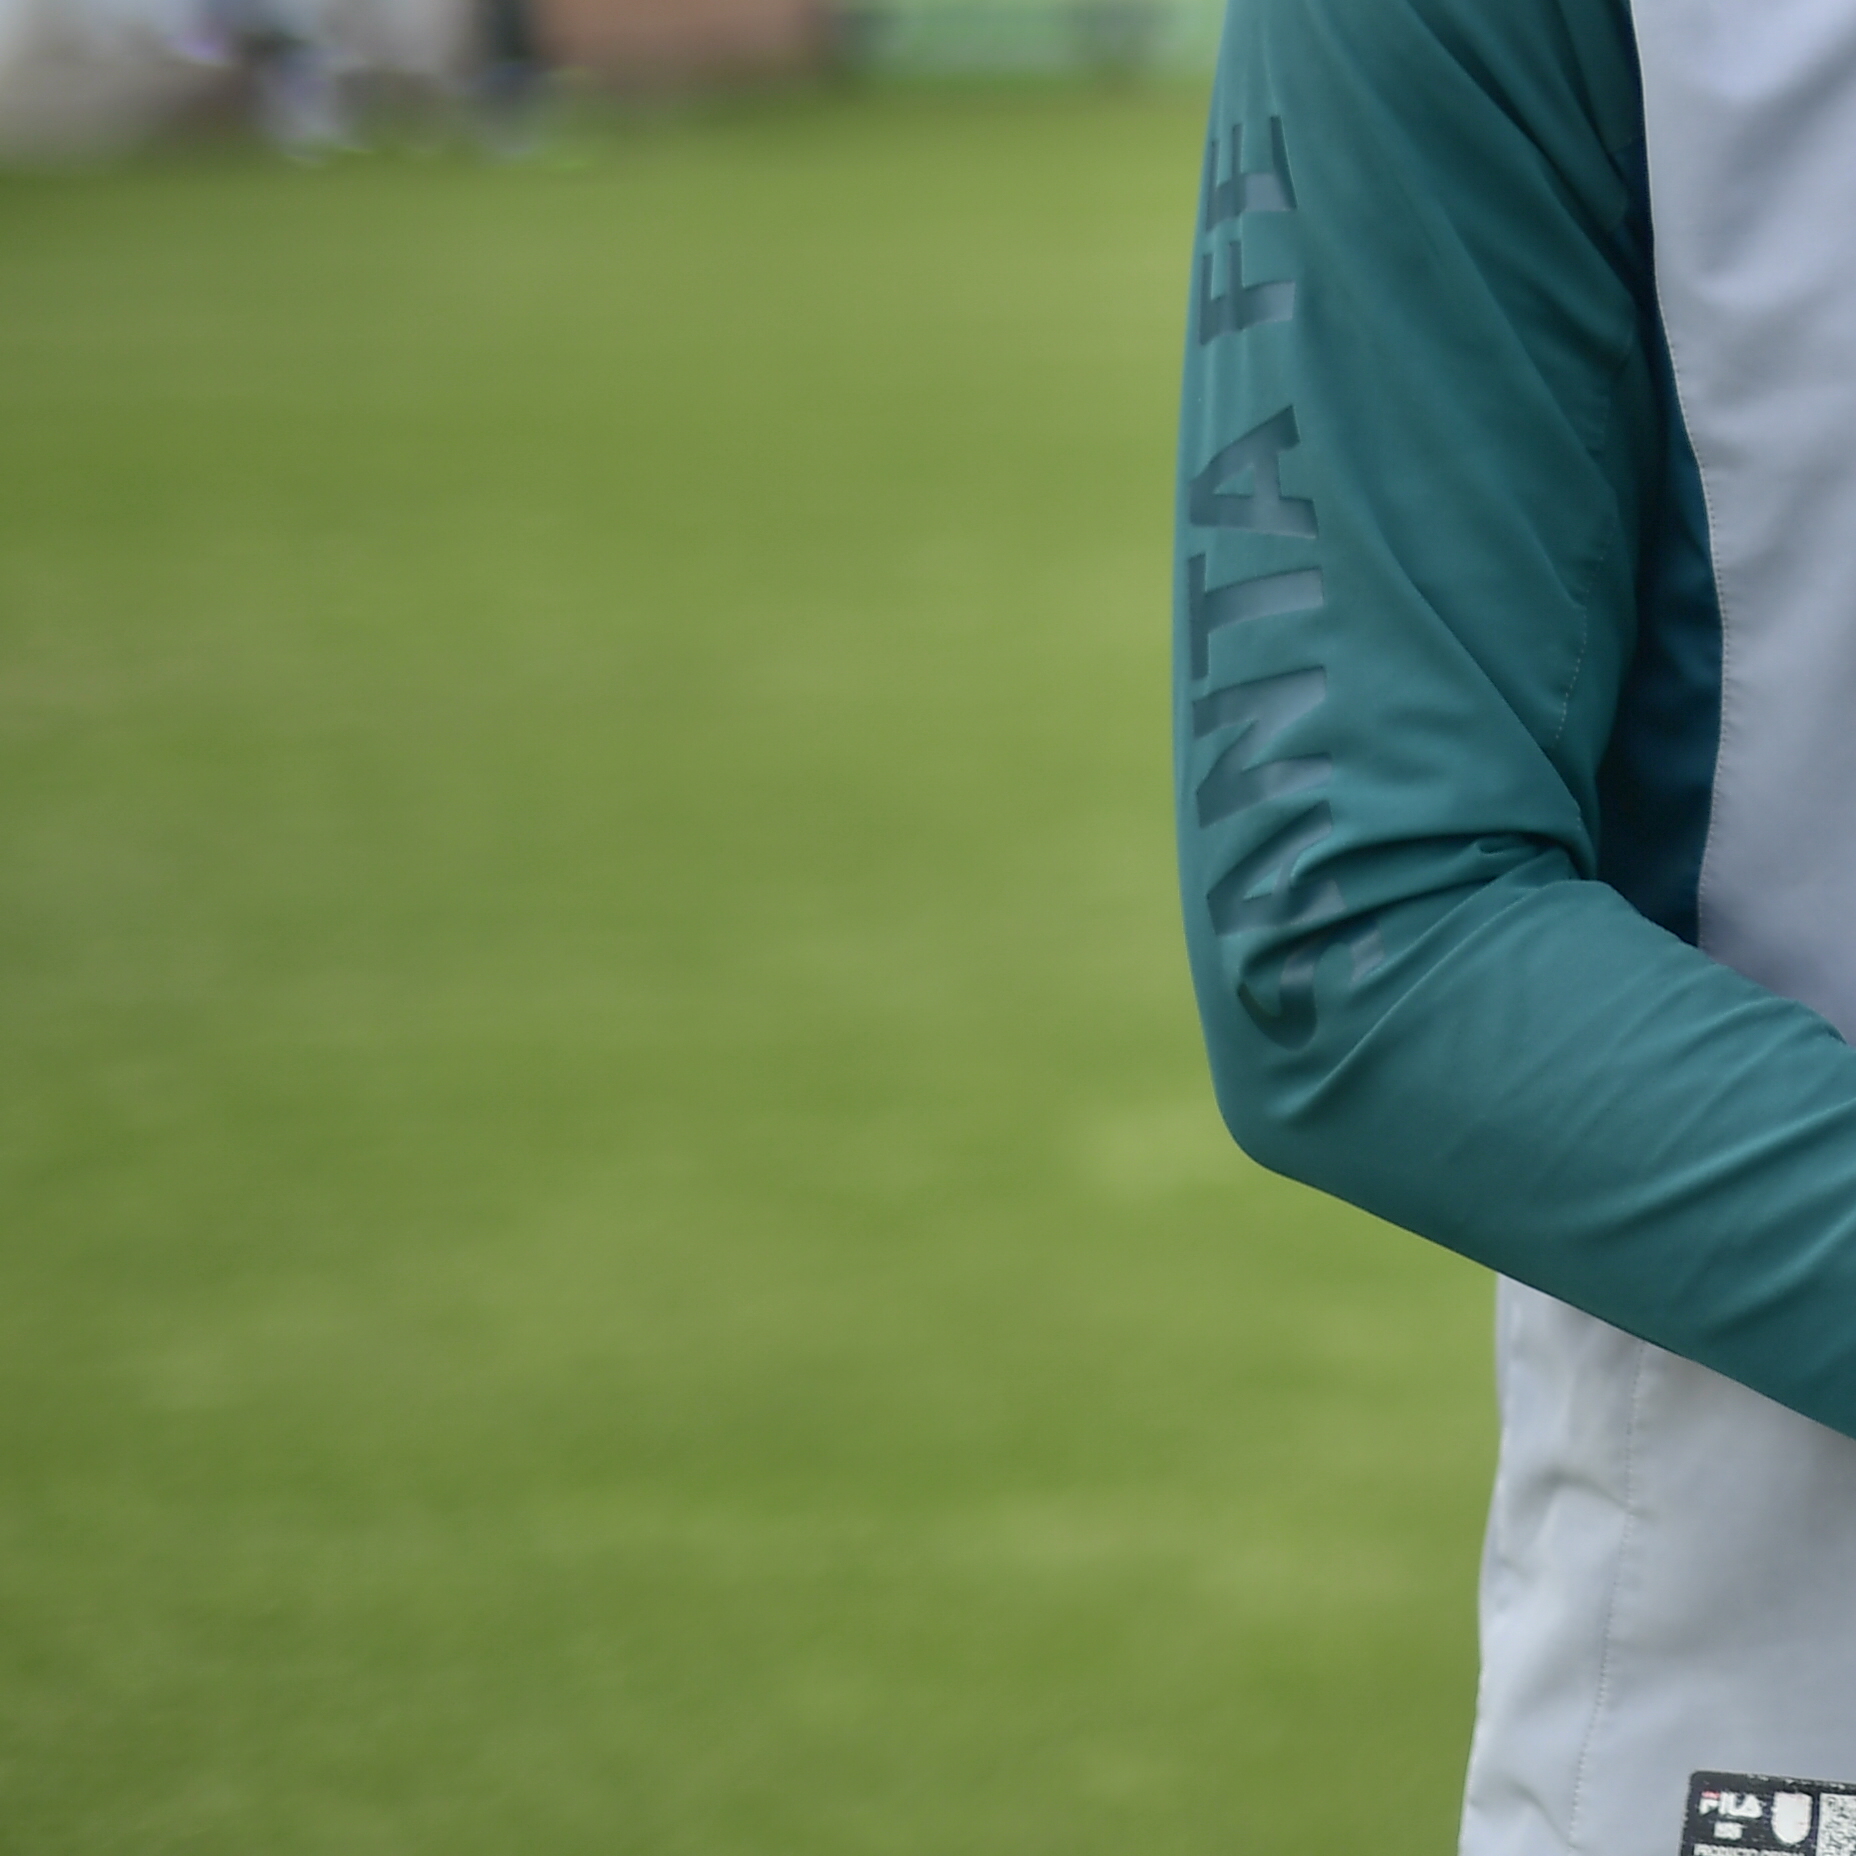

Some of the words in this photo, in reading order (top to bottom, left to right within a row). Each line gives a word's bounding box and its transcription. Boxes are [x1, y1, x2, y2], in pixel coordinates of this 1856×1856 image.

[1199, 115, 1298, 346] FE
[1188, 403, 1386, 1050] SANTA
[1700, 1790, 1763, 1819] FILA
